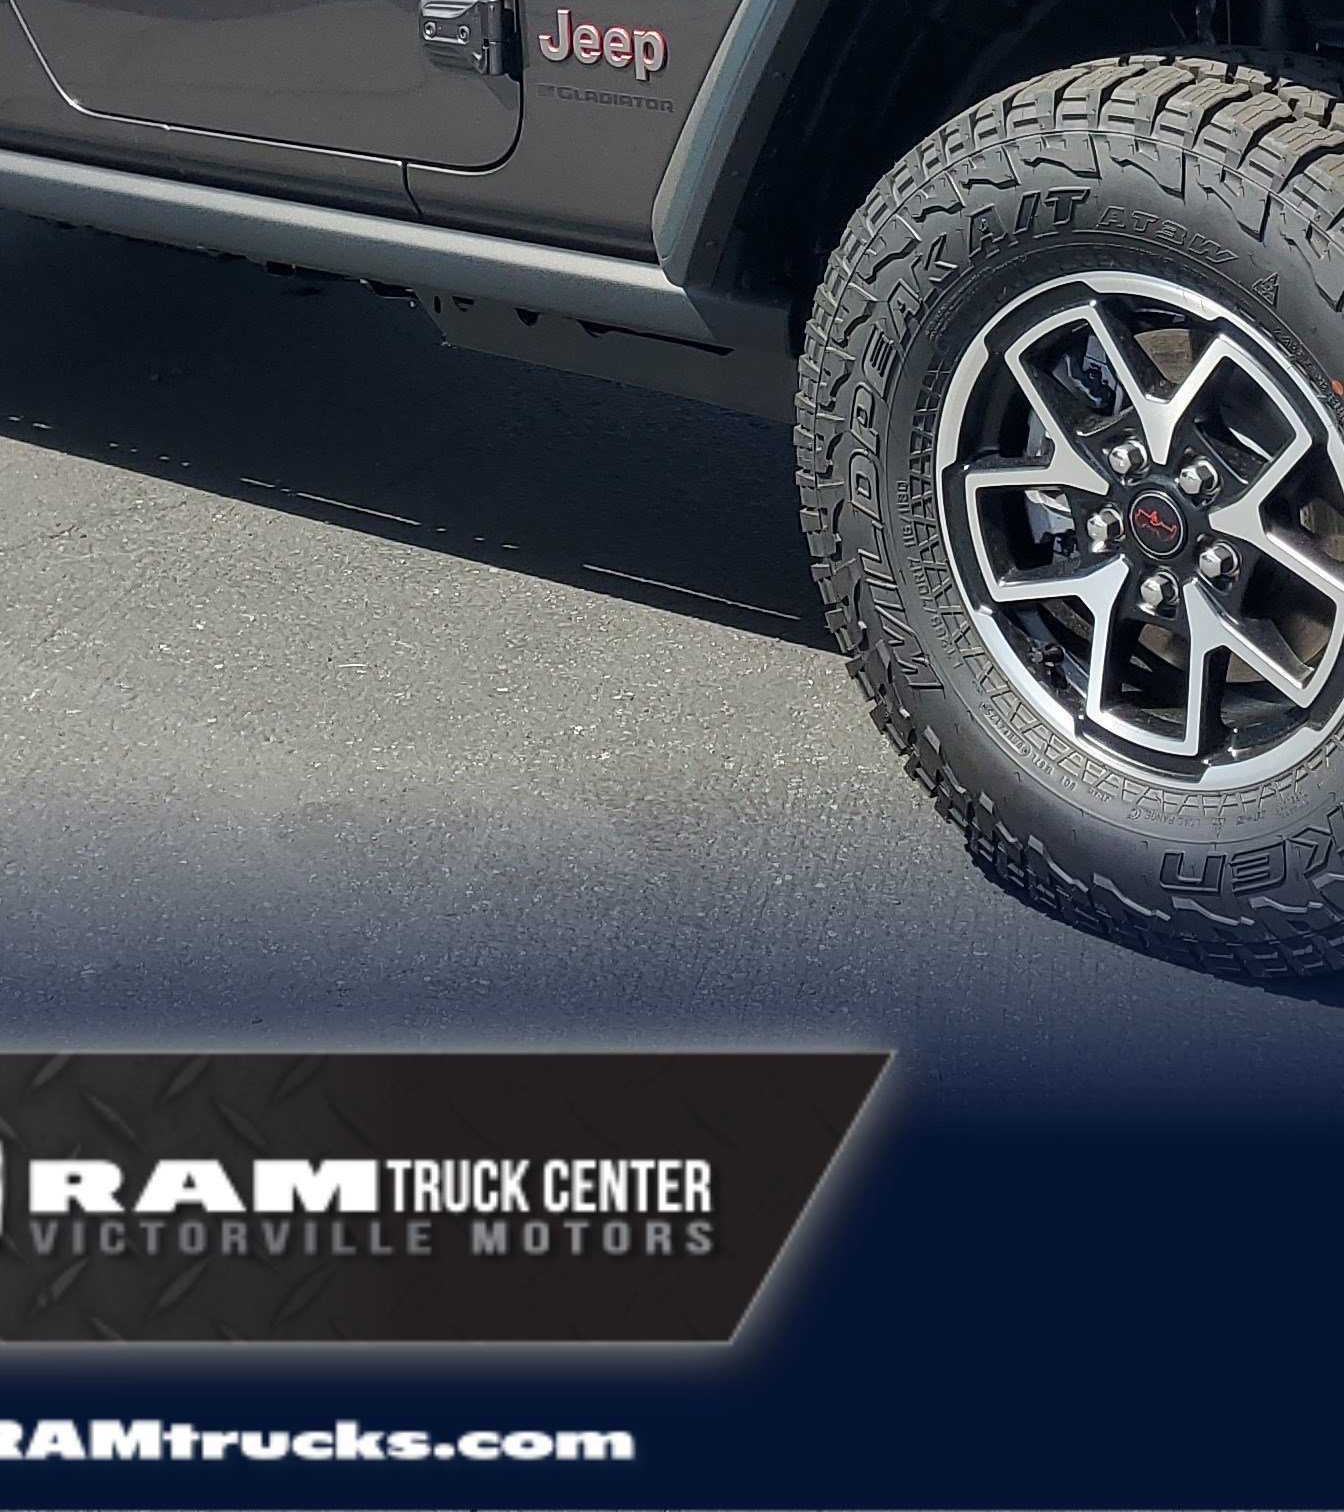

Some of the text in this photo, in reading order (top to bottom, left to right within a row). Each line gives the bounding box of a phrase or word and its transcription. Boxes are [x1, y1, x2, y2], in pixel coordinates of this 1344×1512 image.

[538, 8, 669, 83] Jeep
[556, 86, 675, 114] GLADIATOR
[848, 233, 959, 691] WILDPEAK
